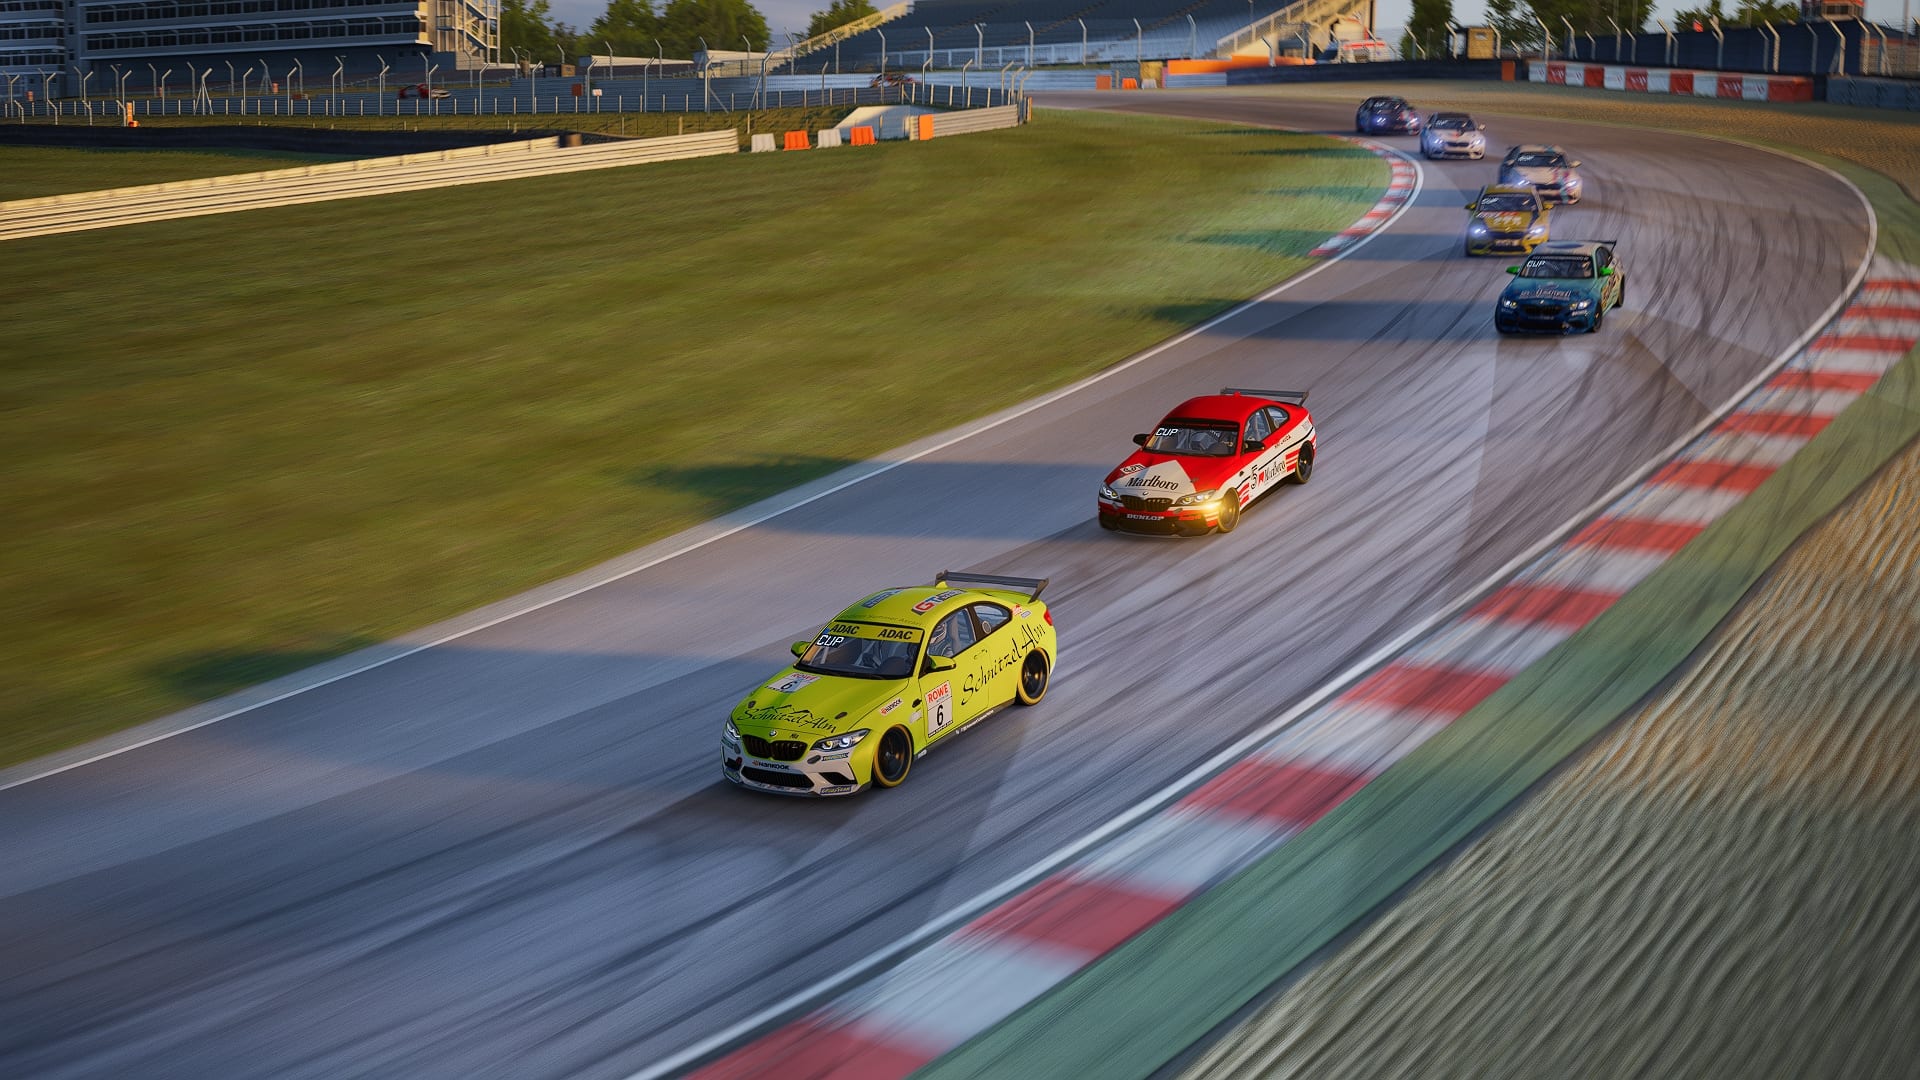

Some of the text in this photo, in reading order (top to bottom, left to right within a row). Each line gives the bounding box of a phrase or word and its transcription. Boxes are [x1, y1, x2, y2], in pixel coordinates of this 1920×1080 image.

[1155, 427, 1178, 436] CUP
[1124, 475, 1179, 491] Marlboro
[1126, 513, 1165, 521] DUNLOP
[830, 624, 860, 635] ADAC
[877, 628, 913, 640] ADAC
[816, 634, 844, 647] CUP
[960, 623, 1046, 706] Schnitzel Alm
[780, 681, 798, 690] 6
[927, 683, 949, 704] ROWE
[737, 707, 837, 733] Schnitzel Alm
[936, 704, 944, 726] 6
